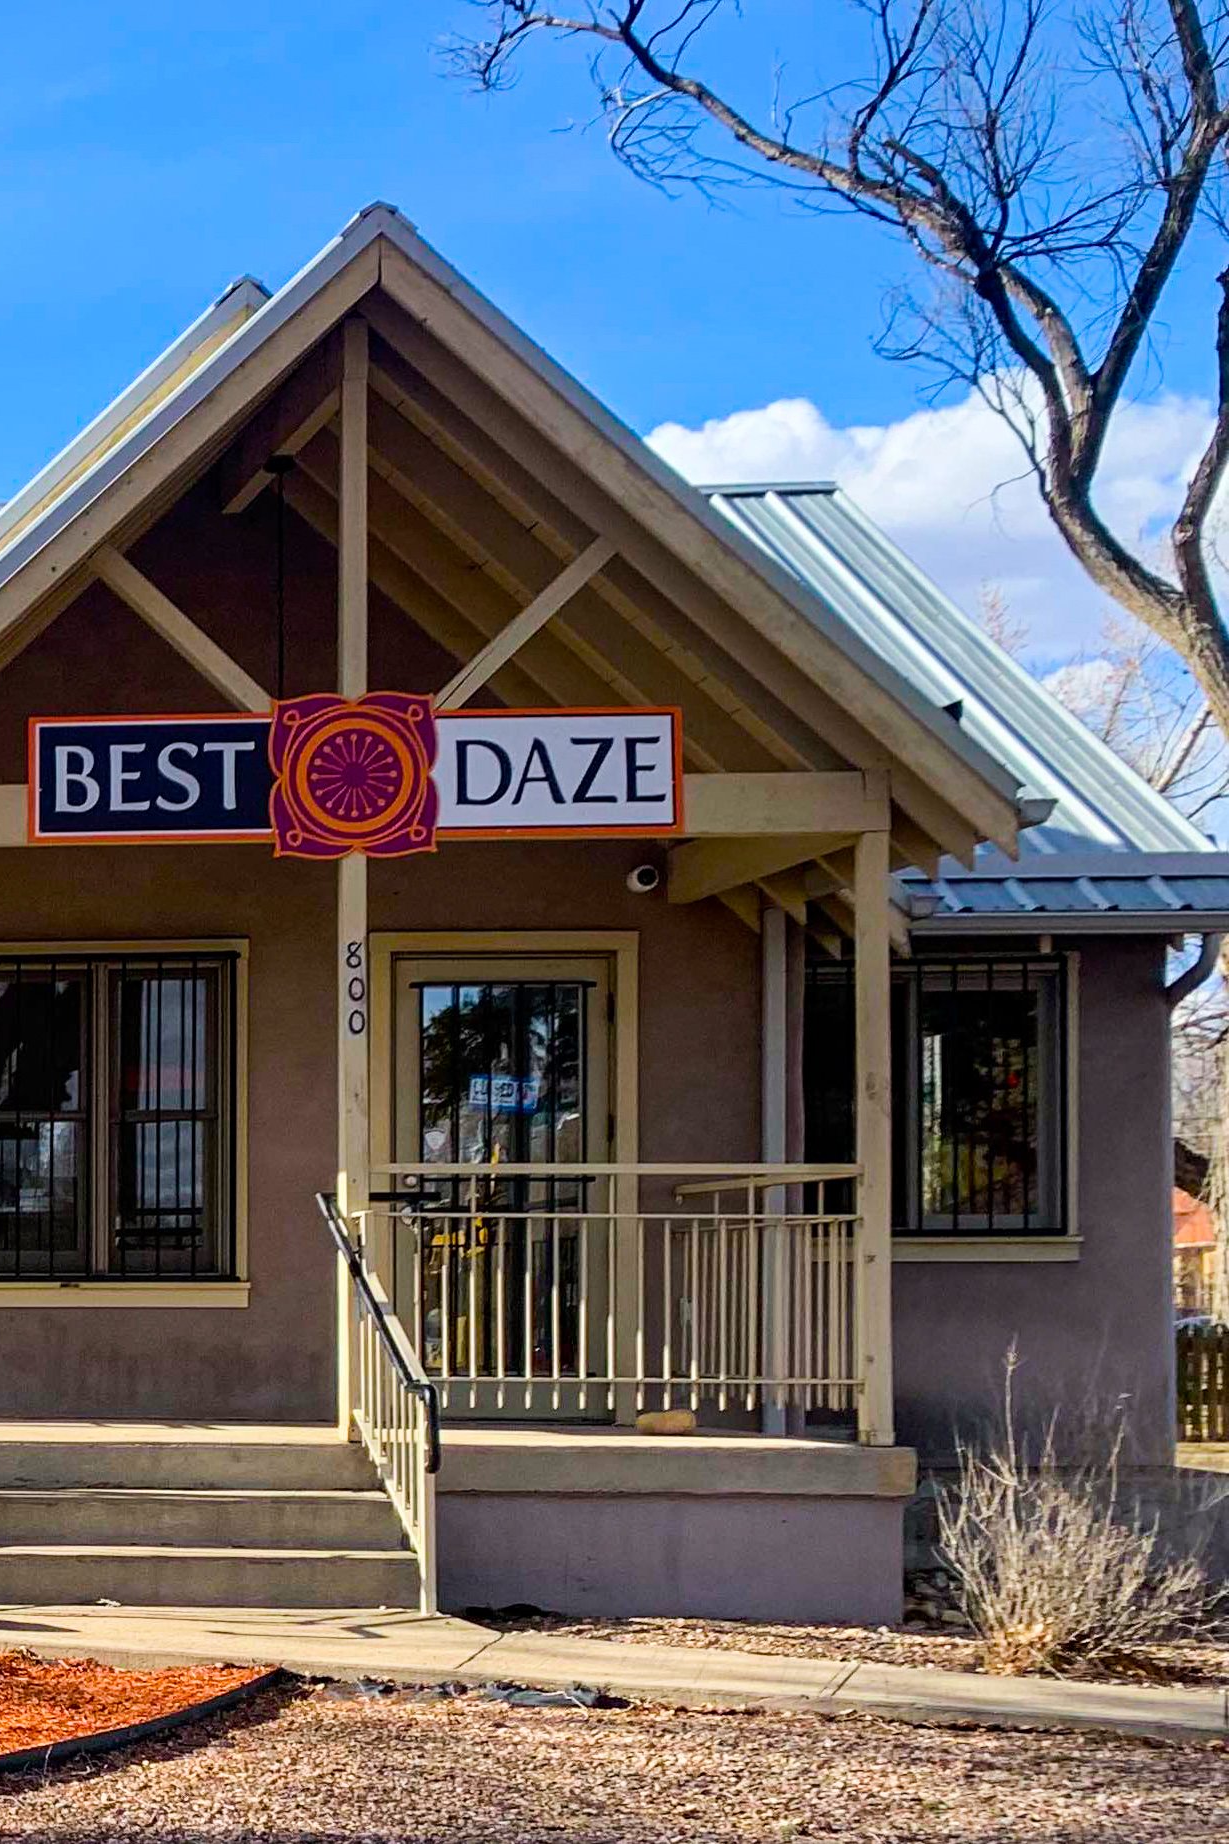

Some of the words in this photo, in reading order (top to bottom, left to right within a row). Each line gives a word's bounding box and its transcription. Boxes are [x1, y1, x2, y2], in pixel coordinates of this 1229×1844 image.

[54, 741, 255, 813] BEST
[455, 736, 667, 805] DAZE
[346, 941, 365, 1034] 800
